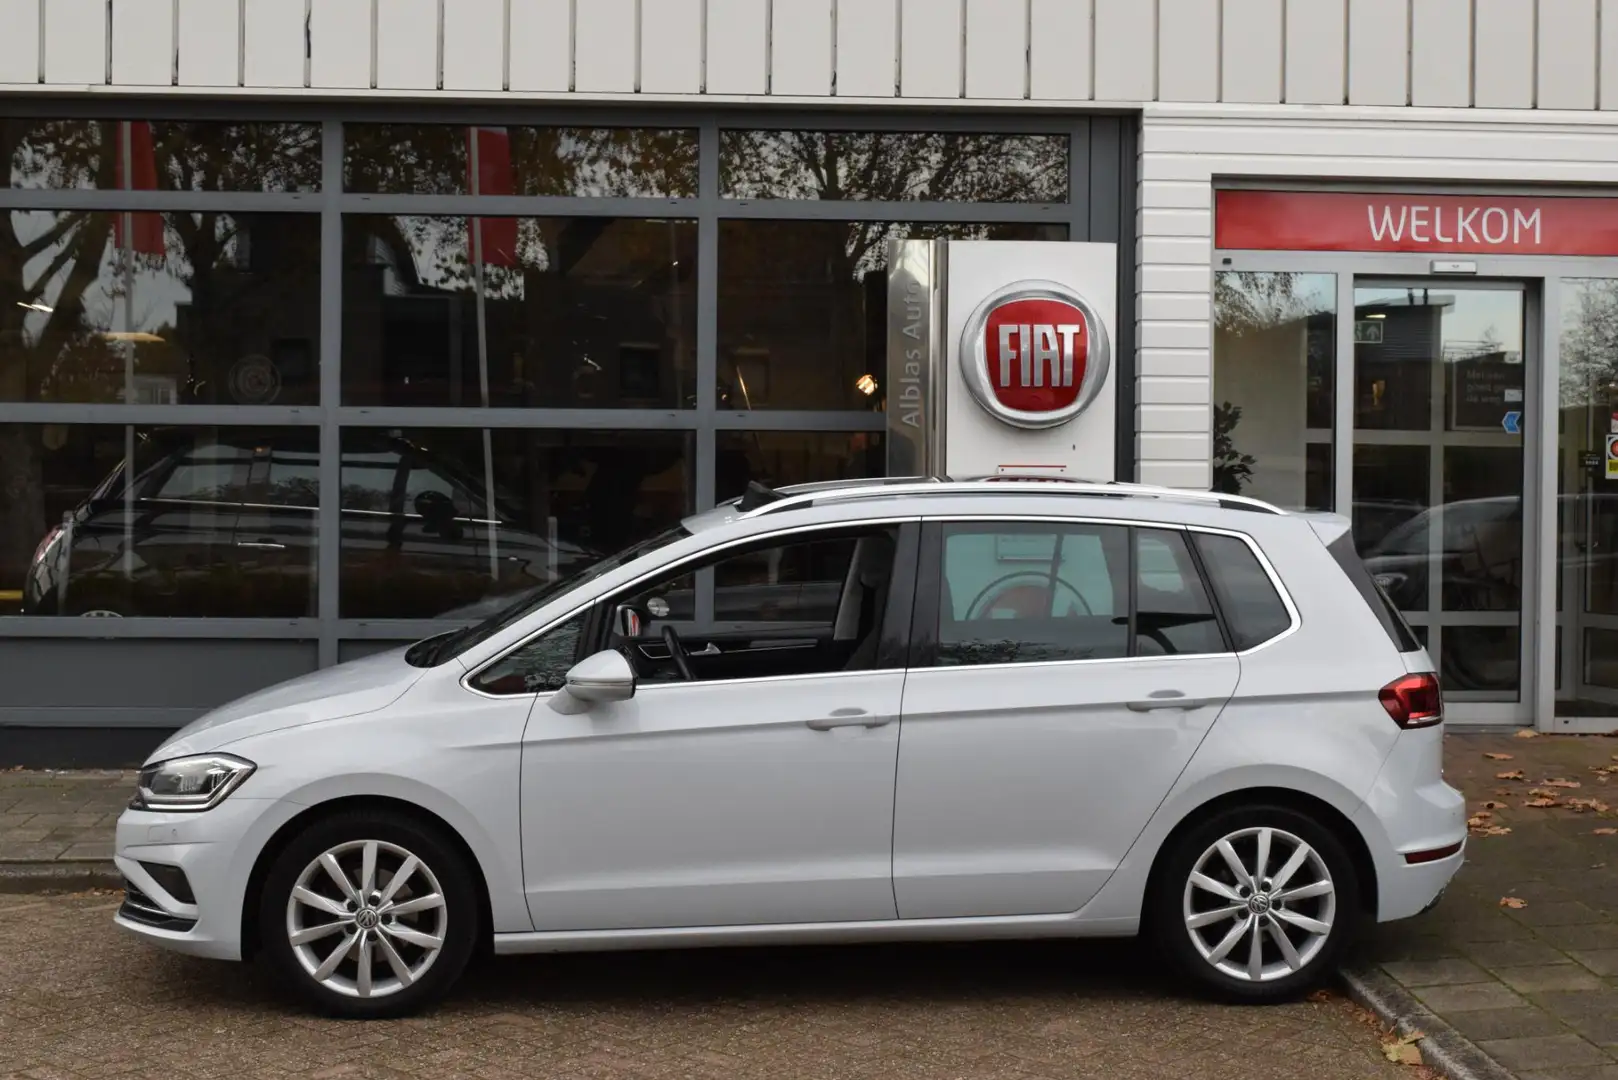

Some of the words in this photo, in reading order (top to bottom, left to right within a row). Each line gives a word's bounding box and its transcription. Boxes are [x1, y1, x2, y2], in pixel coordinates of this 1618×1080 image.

[1367, 205, 1541, 244] WELKOM
[902, 282, 922, 340] Auto
[998, 324, 1080, 387] FIAT
[898, 348, 922, 428] Alblas
